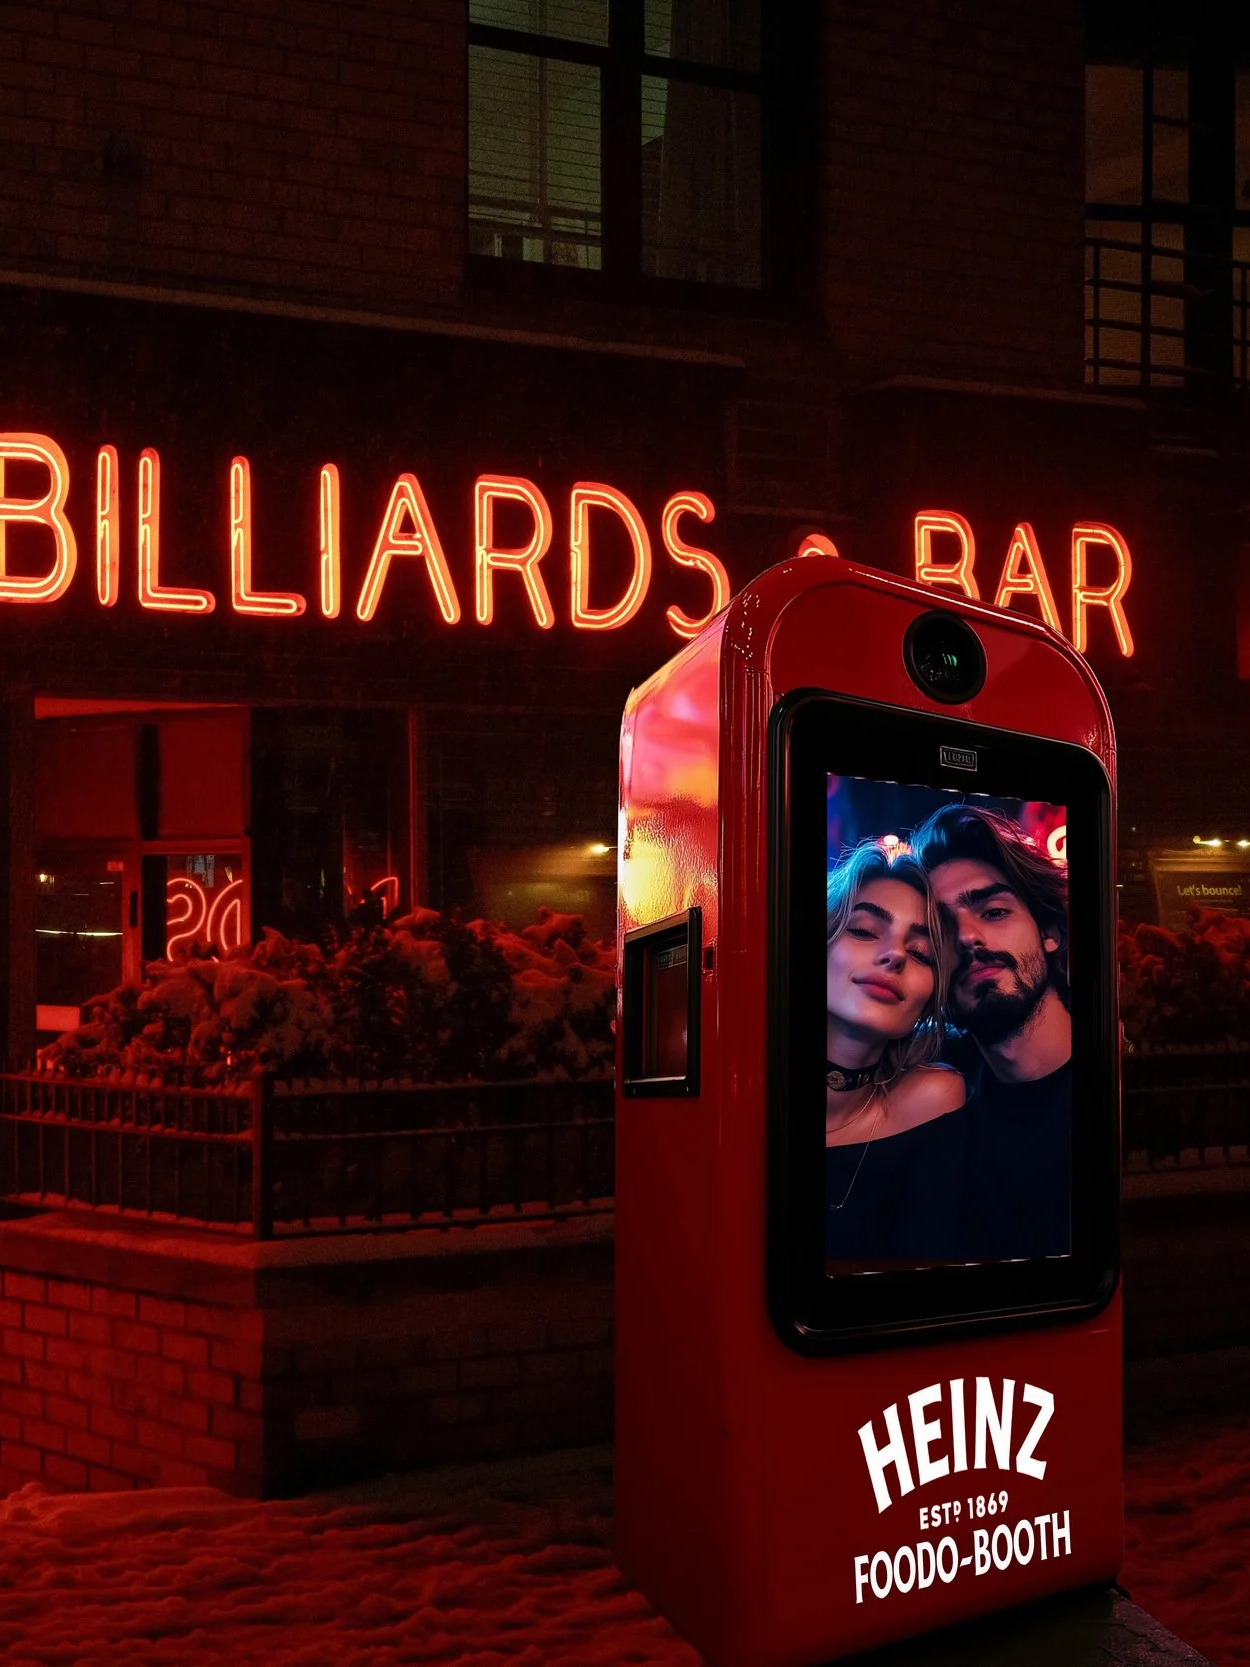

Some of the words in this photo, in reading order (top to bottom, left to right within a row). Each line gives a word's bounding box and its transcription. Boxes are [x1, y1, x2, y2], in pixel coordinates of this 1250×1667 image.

[914, 509, 1135, 658] BAR
[857, 1376, 1054, 1514] HEINZ
[854, 1509, 1072, 1604] FOODO-BOOTH
[967, 1490, 1009, 1520] 1869
